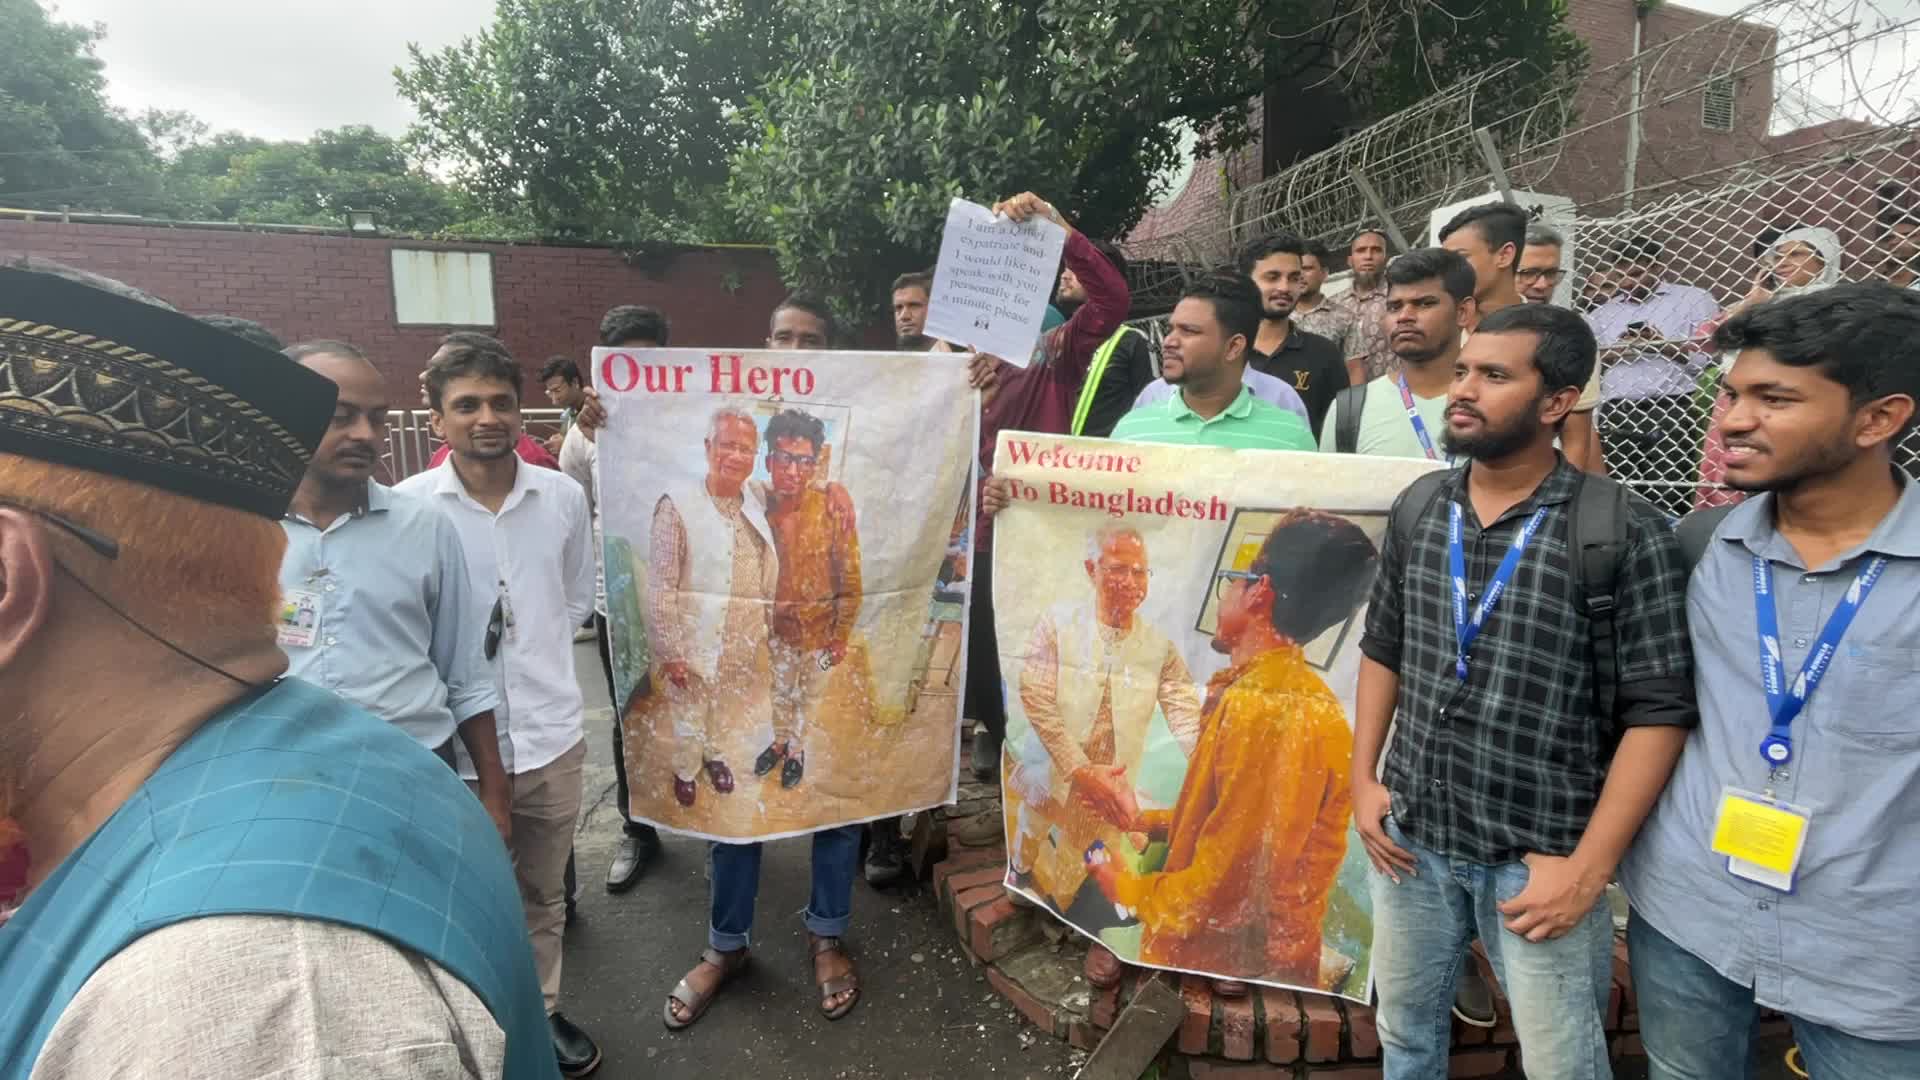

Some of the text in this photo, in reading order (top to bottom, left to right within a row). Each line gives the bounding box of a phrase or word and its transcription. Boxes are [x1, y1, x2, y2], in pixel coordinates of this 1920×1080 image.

[975, 223, 997, 234] am
[963, 253, 1001, 266] would
[1004, 254, 1028, 271] like
[1029, 265, 1041, 278] to
[1023, 244, 1045, 259] and
[950, 264, 1039, 294] speak with you
[950, 279, 1032, 308] personally for
[952, 295, 993, 313] minute
[994, 304, 1030, 325] please
[601, 351, 815, 396] Our Hero
[1007, 439, 1142, 474] Welcome
[1006, 477, 1229, 521] To Bangladesh
